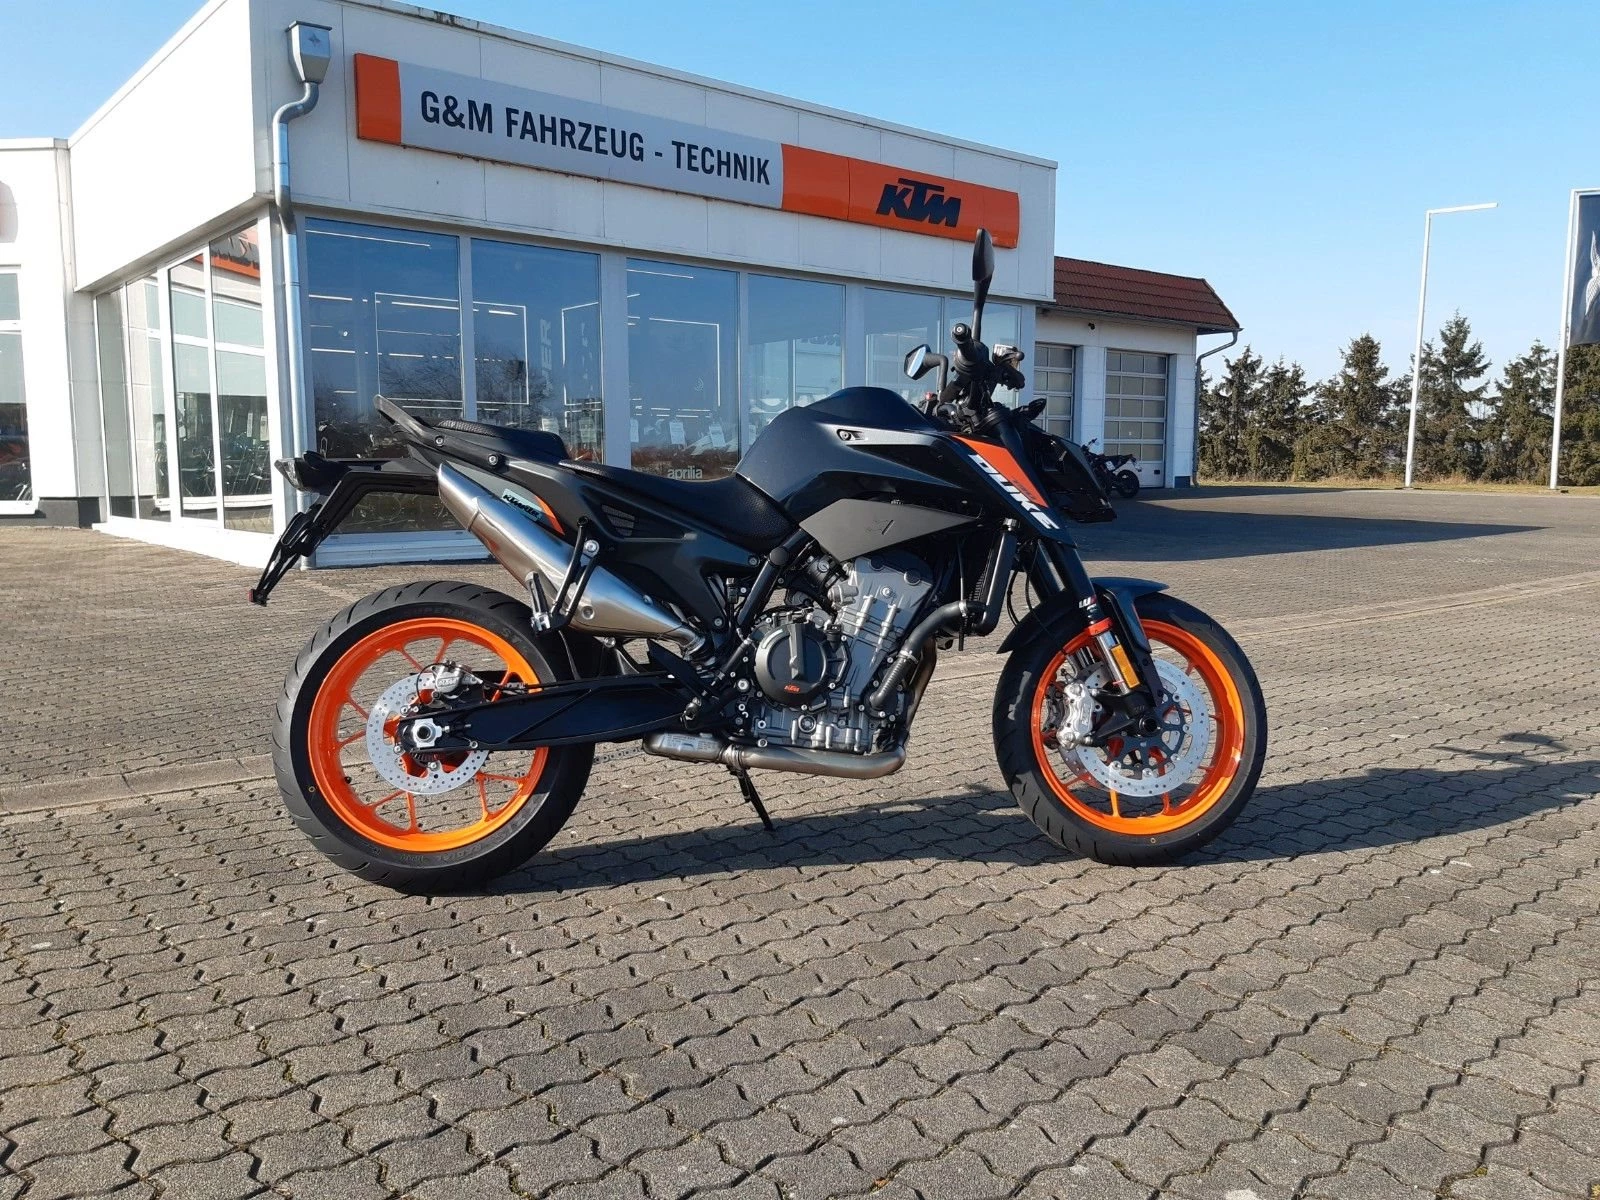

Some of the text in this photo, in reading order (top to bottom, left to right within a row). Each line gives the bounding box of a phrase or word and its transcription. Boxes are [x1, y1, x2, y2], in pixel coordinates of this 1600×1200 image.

[420, 90, 493, 134] G&M
[505, 107, 644, 161] FAHRZEUG
[671, 140, 770, 186] TECHNIK
[876, 177, 961, 228] KTM
[667, 465, 703, 480] aprilia
